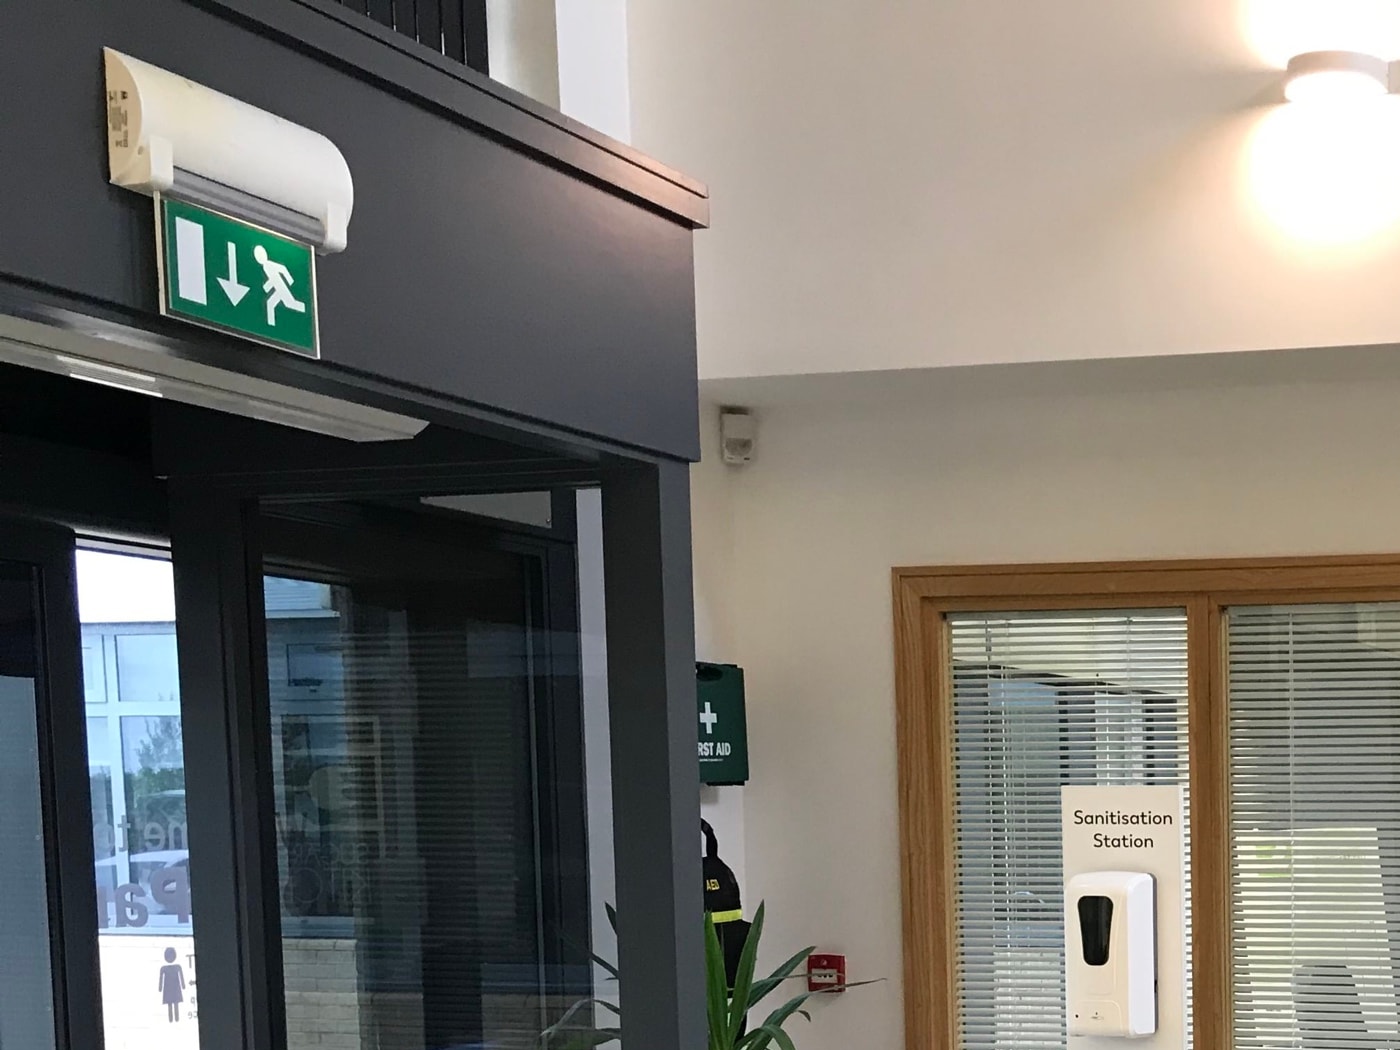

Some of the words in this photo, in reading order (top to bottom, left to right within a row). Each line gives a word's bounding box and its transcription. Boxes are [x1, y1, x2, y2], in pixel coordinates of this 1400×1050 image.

[698, 742, 714, 757] RST
[716, 742, 731, 757] AID
[1073, 809, 1173, 825] Sanitisation
[1093, 833, 1154, 848] Station
